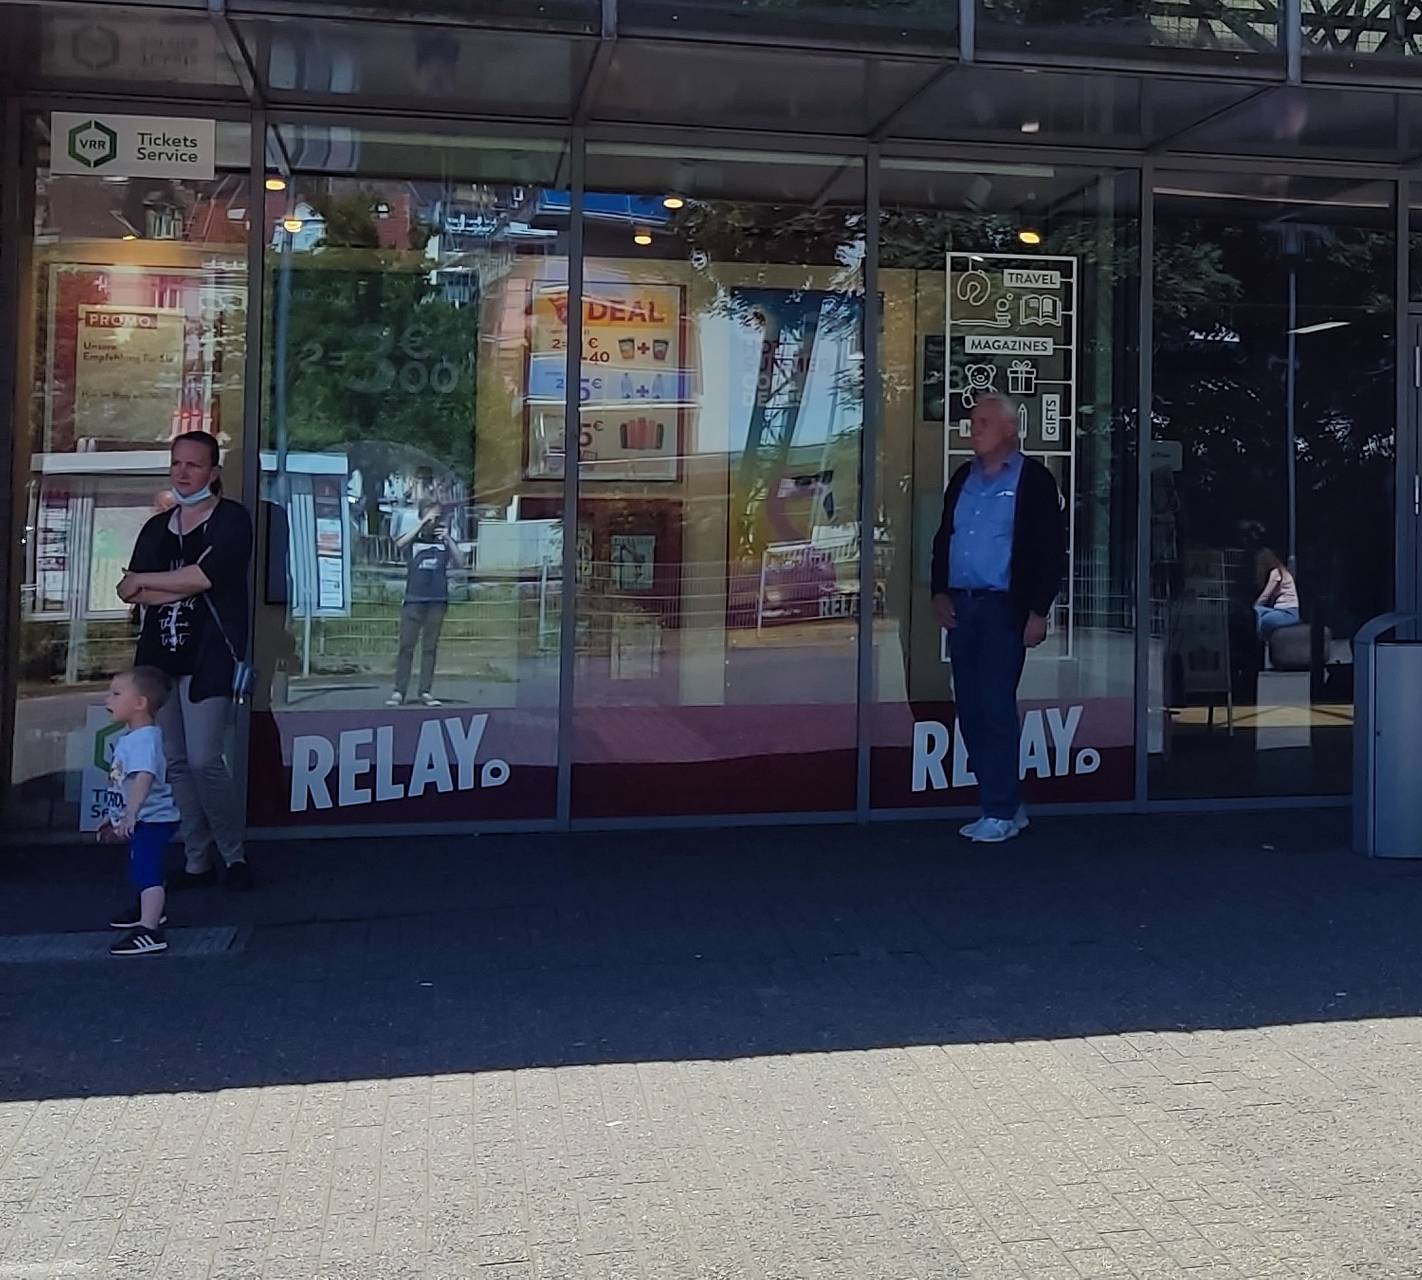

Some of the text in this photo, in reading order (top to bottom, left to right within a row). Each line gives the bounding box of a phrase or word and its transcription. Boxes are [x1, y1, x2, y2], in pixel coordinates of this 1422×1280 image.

[79, 139, 106, 150] VRR
[137, 132, 198, 149] Tickets
[137, 148, 198, 163] Service
[1007, 272, 1058, 286] TRAVEL
[588, 298, 665, 322] DEAL
[89, 313, 152, 328] PROMO
[970, 339, 1048, 353] MAGAZINES
[1045, 400, 1057, 436] GIFTS
[912, 705, 1085, 792] REAY
[290, 713, 489, 813] RELAY
